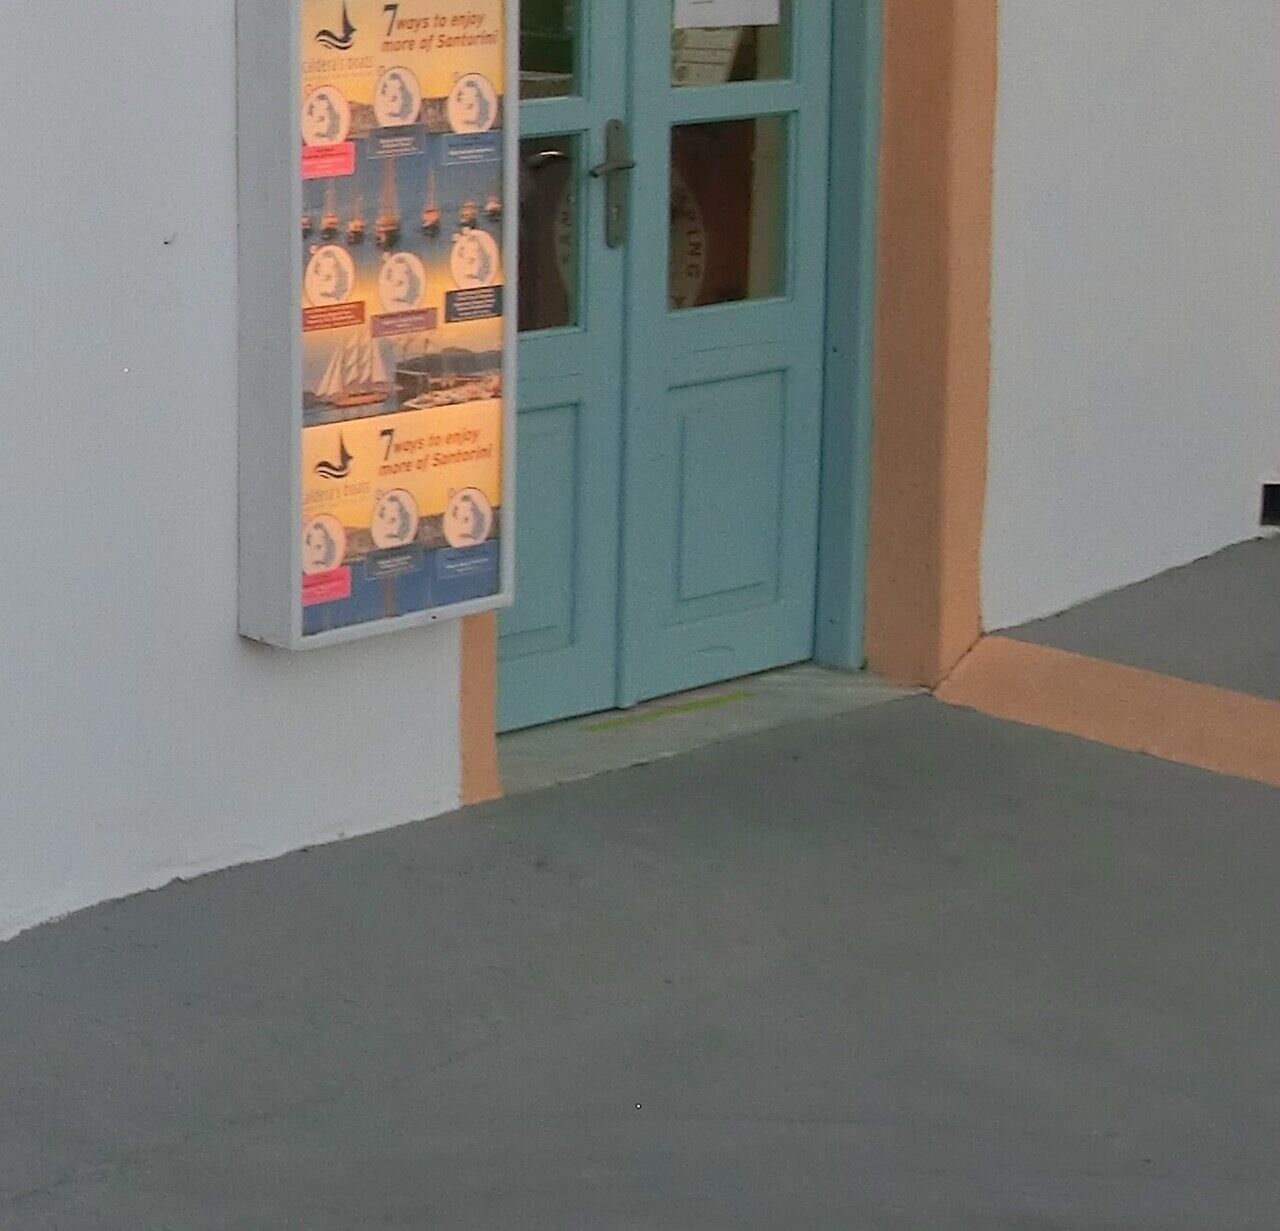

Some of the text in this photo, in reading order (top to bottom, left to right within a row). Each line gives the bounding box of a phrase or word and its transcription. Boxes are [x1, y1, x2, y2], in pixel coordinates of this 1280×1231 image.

[383, 3, 486, 36] 7 ways to enjoy
[380, 29, 499, 53] more of Santorini
[380, 428, 395, 461] 7
[427, 434, 442, 447] to
[445, 427, 481, 446] enjoy
[378, 460, 413, 476] more
[415, 453, 430, 471] of
